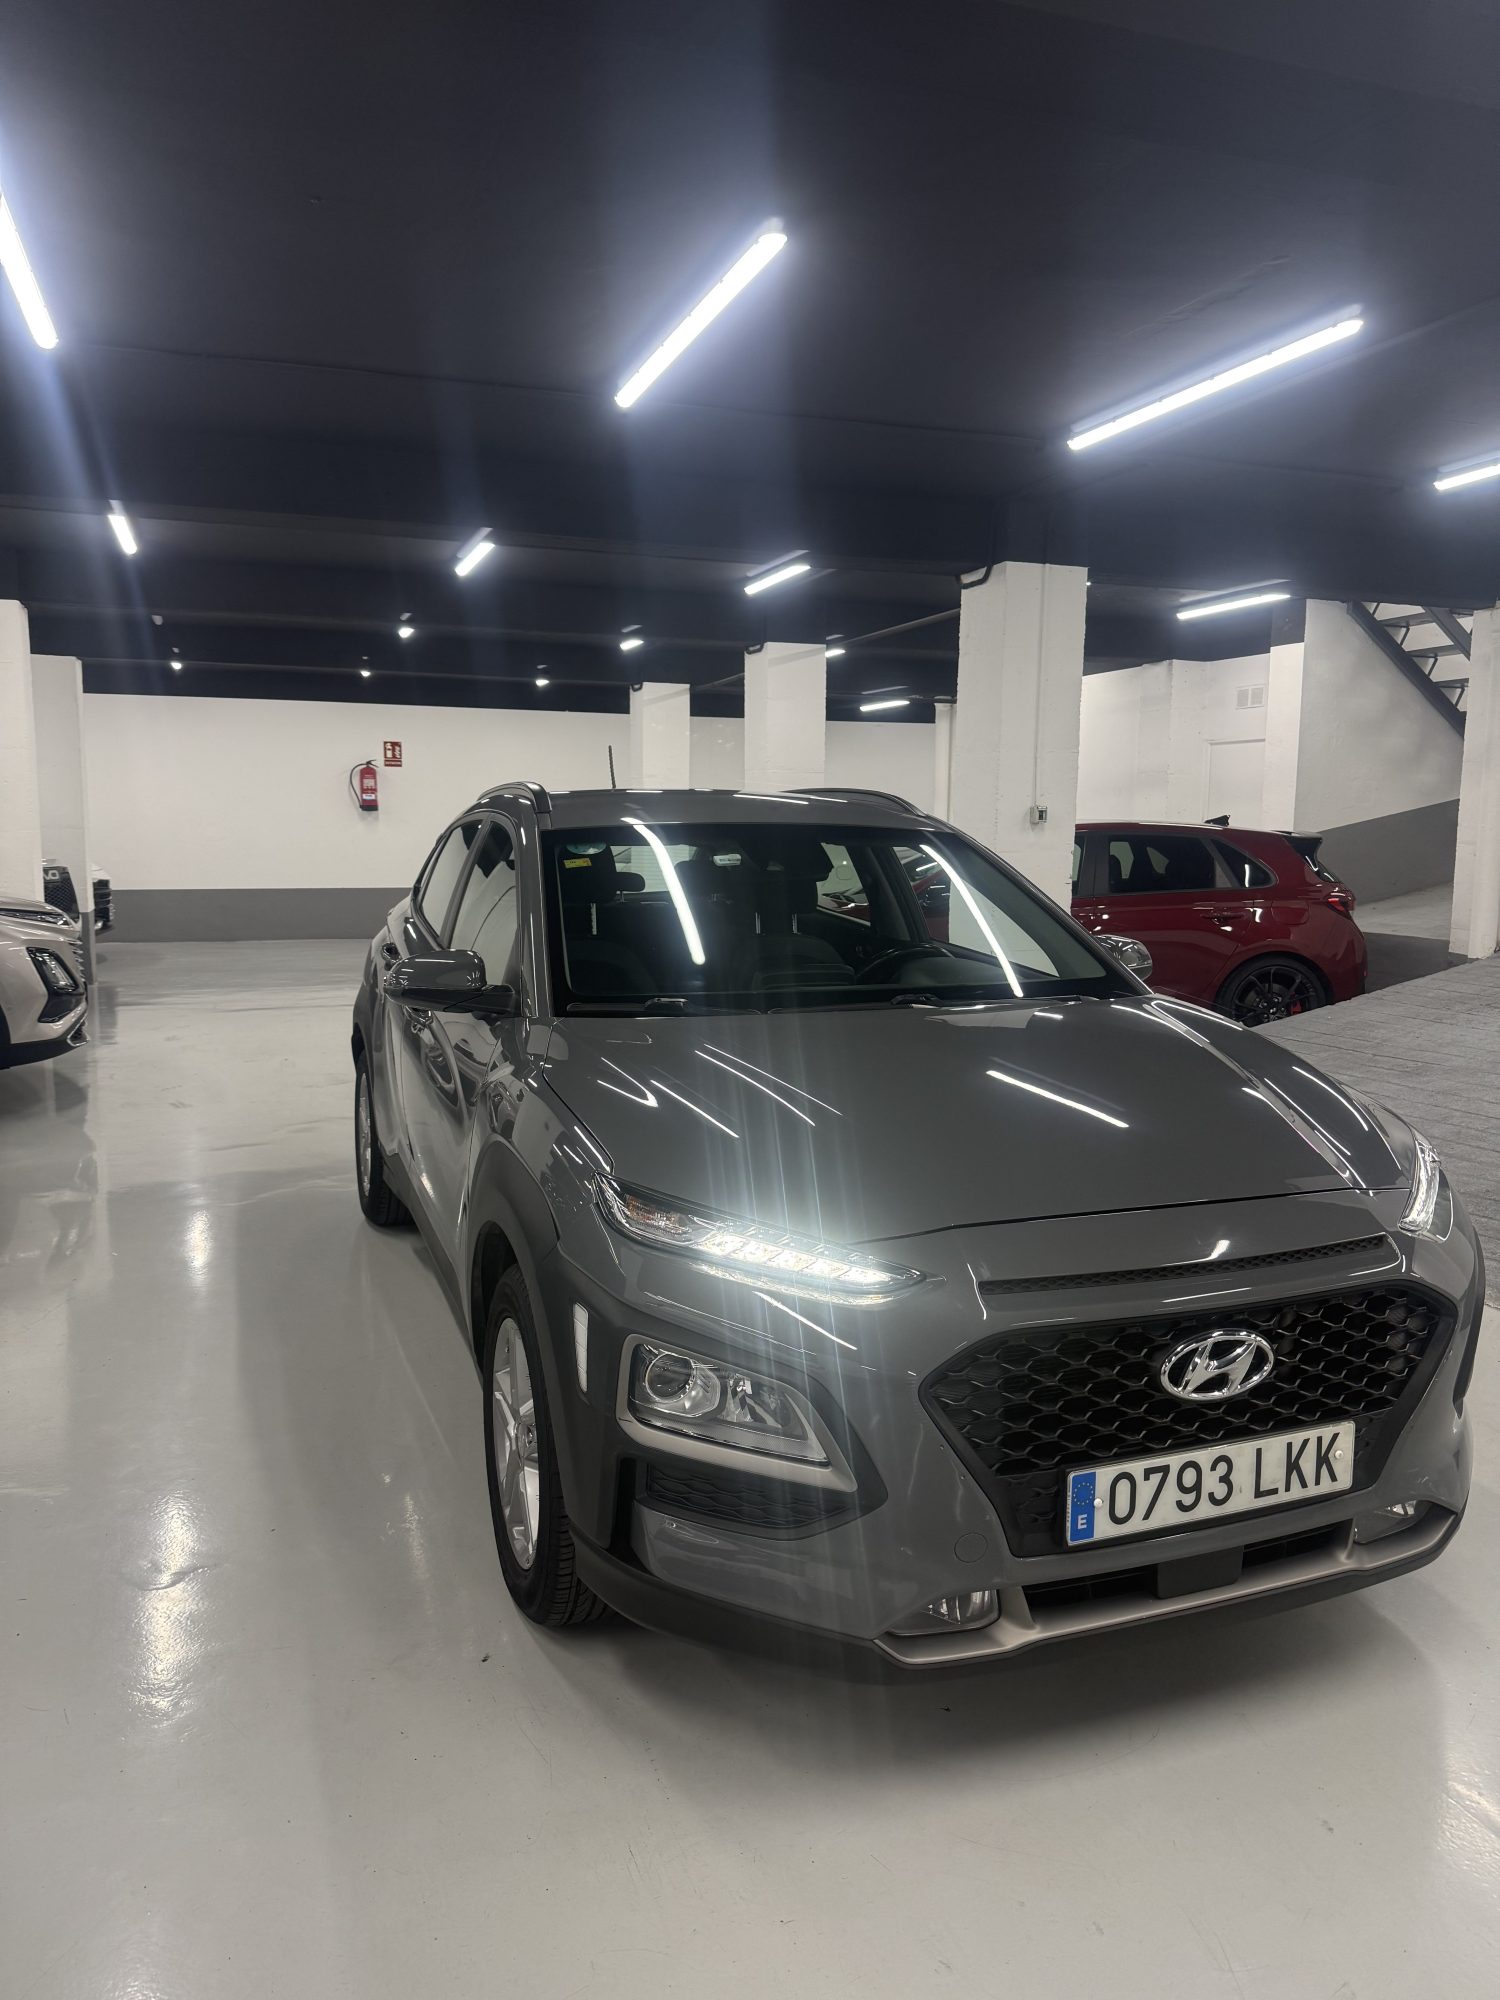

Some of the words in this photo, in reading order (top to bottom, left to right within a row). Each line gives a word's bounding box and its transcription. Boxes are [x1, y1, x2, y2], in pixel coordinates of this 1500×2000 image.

[1108, 1454, 1233, 1525] 0793
[1253, 1432, 1340, 1499] LKK
[1077, 1513, 1088, 1530] E
